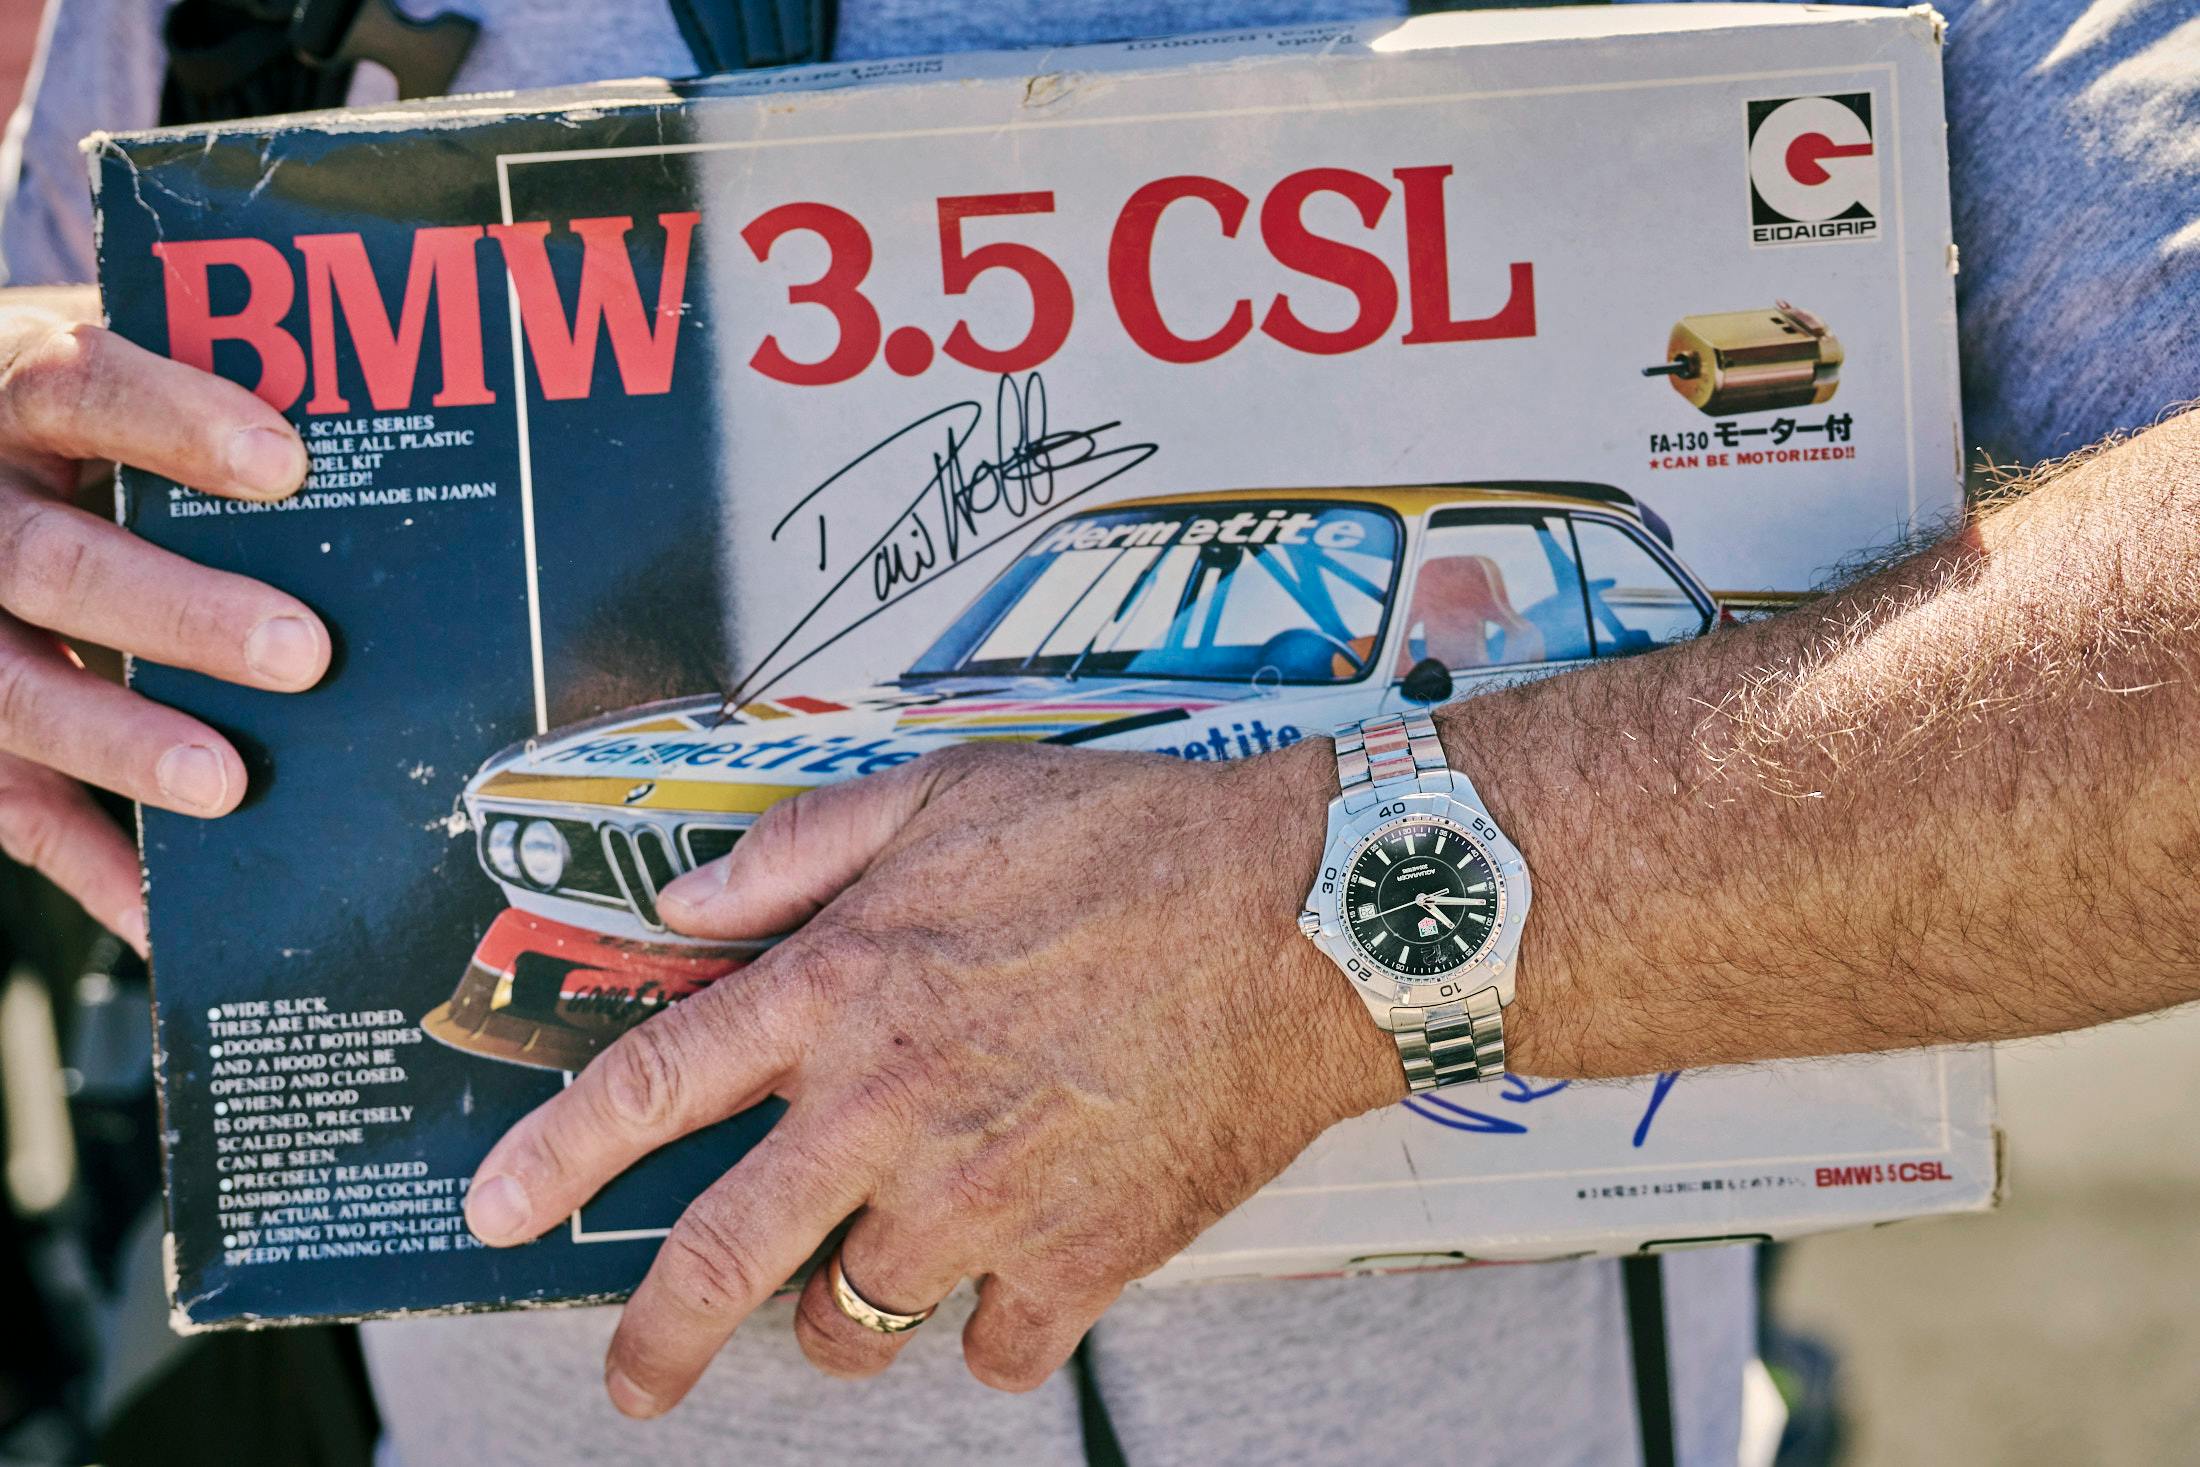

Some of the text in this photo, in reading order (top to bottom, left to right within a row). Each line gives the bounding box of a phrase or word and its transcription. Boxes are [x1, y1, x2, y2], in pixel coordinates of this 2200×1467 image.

[1753, 220, 1877, 242] EIDAIGRIP
[152, 164, 1538, 415] BMW 3.5 CSL
[309, 419, 370, 437] SCALE
[371, 415, 435, 434] SERIES
[1713, 413, 1853, 447] モーター付
[306, 430, 475, 455] MBLE ALL PLASTIC
[1650, 432, 1709, 453] FA-130
[308, 453, 384, 473] DEL KIT
[1706, 454, 1729, 467] BE
[1737, 446, 1856, 464] MOTORIZED!!
[303, 470, 373, 489] RIZED!!
[169, 500, 222, 517] EIDAI
[360, 487, 413, 506] MADE
[416, 484, 437, 502] IN
[440, 482, 497, 501] JAPAN
[1028, 510, 1367, 558] Hermetite
[1156, 720, 1302, 761] etite
[1379, 801, 1406, 818] 40
[1471, 817, 1497, 842] 50
[1322, 867, 1337, 894] 30
[1397, 868, 1436, 882] AQUARACER
[1346, 958, 1373, 982] 20
[1440, 981, 1462, 998] 10
[221, 997, 328, 1018] WIDE SLICK
[209, 1019, 262, 1037] TIRES
[265, 1016, 302, 1034] ARE
[224, 1028, 422, 1055] DOORS AT BOTH SIDES
[211, 1049, 396, 1076] AND A HOOD CAN BE
[210, 1076, 286, 1095] OPENED
[290, 1072, 329, 1090] AND
[227, 1089, 359, 1112] WHEN A HOOD
[214, 1118, 231, 1133] IS
[316, 1105, 414, 1126] PRECISELY
[216, 1128, 364, 1152] SCALED ENGINE
[216, 1154, 258, 1172] CAN
[261, 1152, 285, 1168] BE
[233, 1161, 428, 1189] PRECISELY REALIZED
[218, 1186, 331, 1210] DASHBOARD
[333, 1183, 373, 1201] AND
[375, 1178, 455, 1198] COCKPIT
[218, 1212, 254, 1229] THE
[260, 1206, 333, 1225] ACTUAL
[338, 1197, 457, 1219] ATMOSPHERE
[237, 1230, 261, 1246] BY
[265, 1224, 321, 1243] USING
[325, 1222, 366, 1239] TWO
[224, 1246, 294, 1266] SPEEDY
[297, 1239, 382, 1261] RUNNING
[385, 1235, 425, 1253] CAN
[428, 1234, 449, 1250] BE
